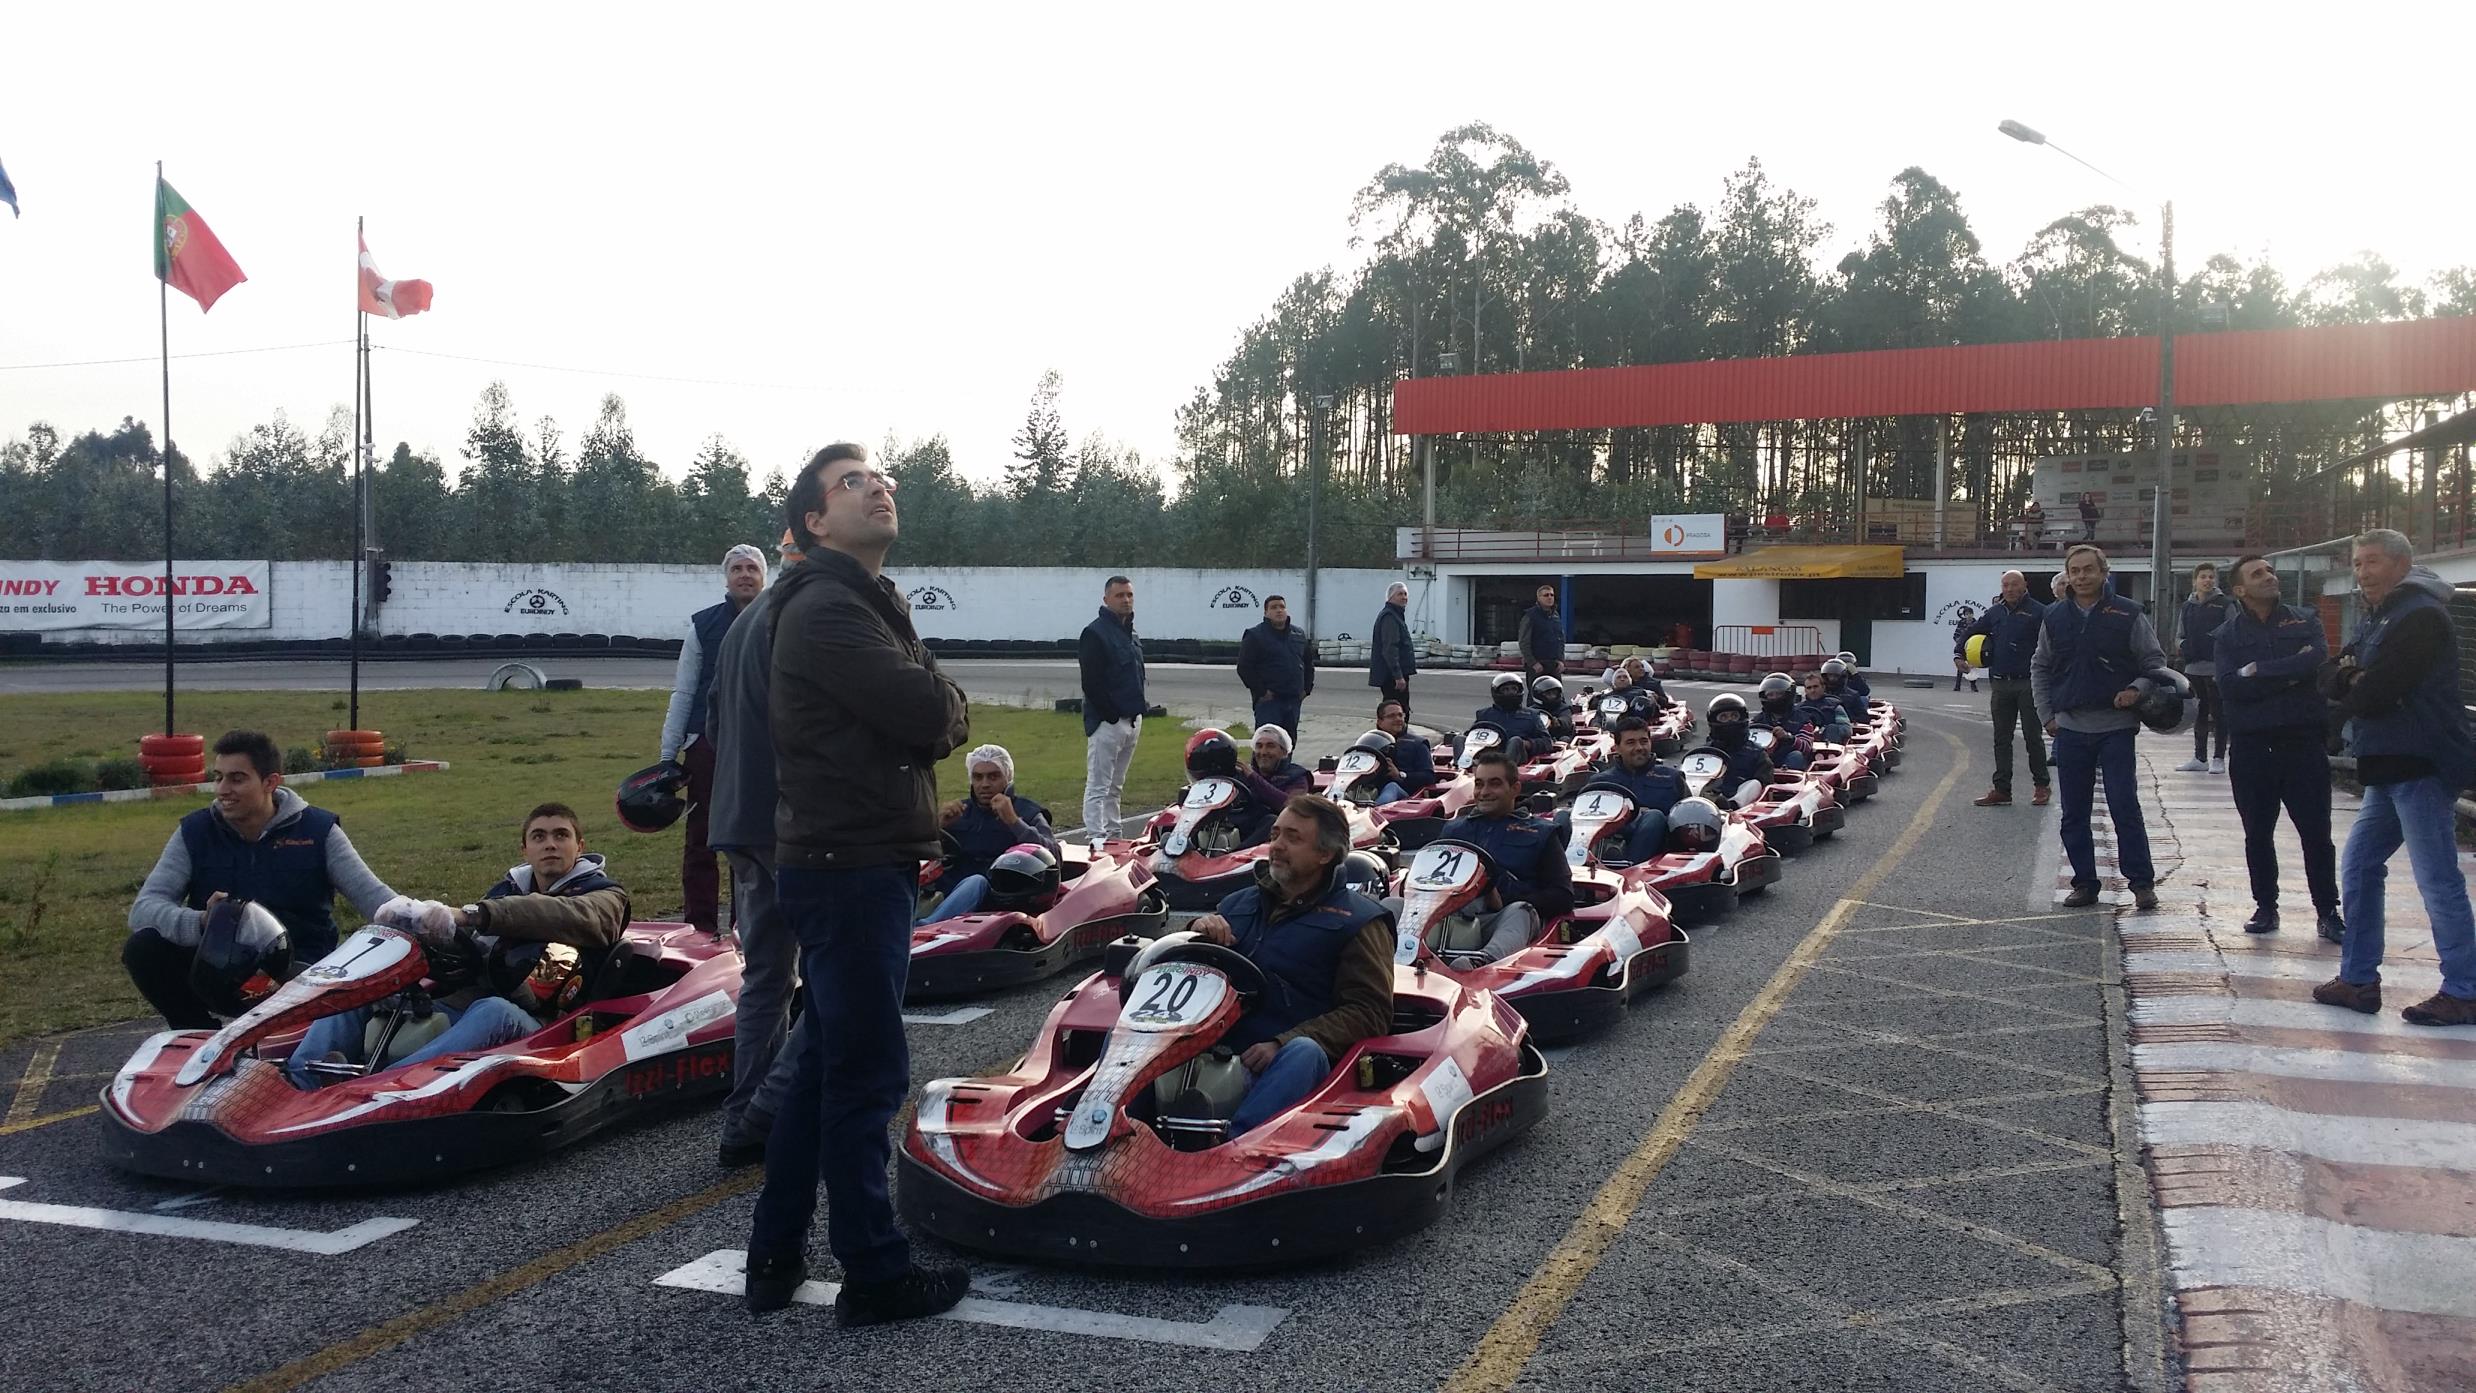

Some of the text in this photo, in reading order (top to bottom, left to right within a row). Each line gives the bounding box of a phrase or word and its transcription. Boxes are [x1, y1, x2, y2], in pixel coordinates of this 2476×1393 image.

[84, 576, 258, 596] HONDA
[504, 588, 569, 615] ESCOLA KARTING
[929, 585, 957, 610] KARTING
[1210, 585, 1260, 608] ESCOLA KARTING
[14, 605, 29, 613] em
[32, 603, 77, 613] exclusivo
[101, 602, 247, 613] The Powe of Dreams
[1933, 599, 1988, 625] ESCOLA KART
[1475, 731, 1490, 741] 18
[1345, 755, 1360, 769] 12
[1695, 758, 1705, 771] 5
[1203, 783, 1218, 800] 3
[1588, 794, 1602, 813] 4
[1431, 850, 1463, 879] 21
[1139, 972, 1198, 1013] 20
